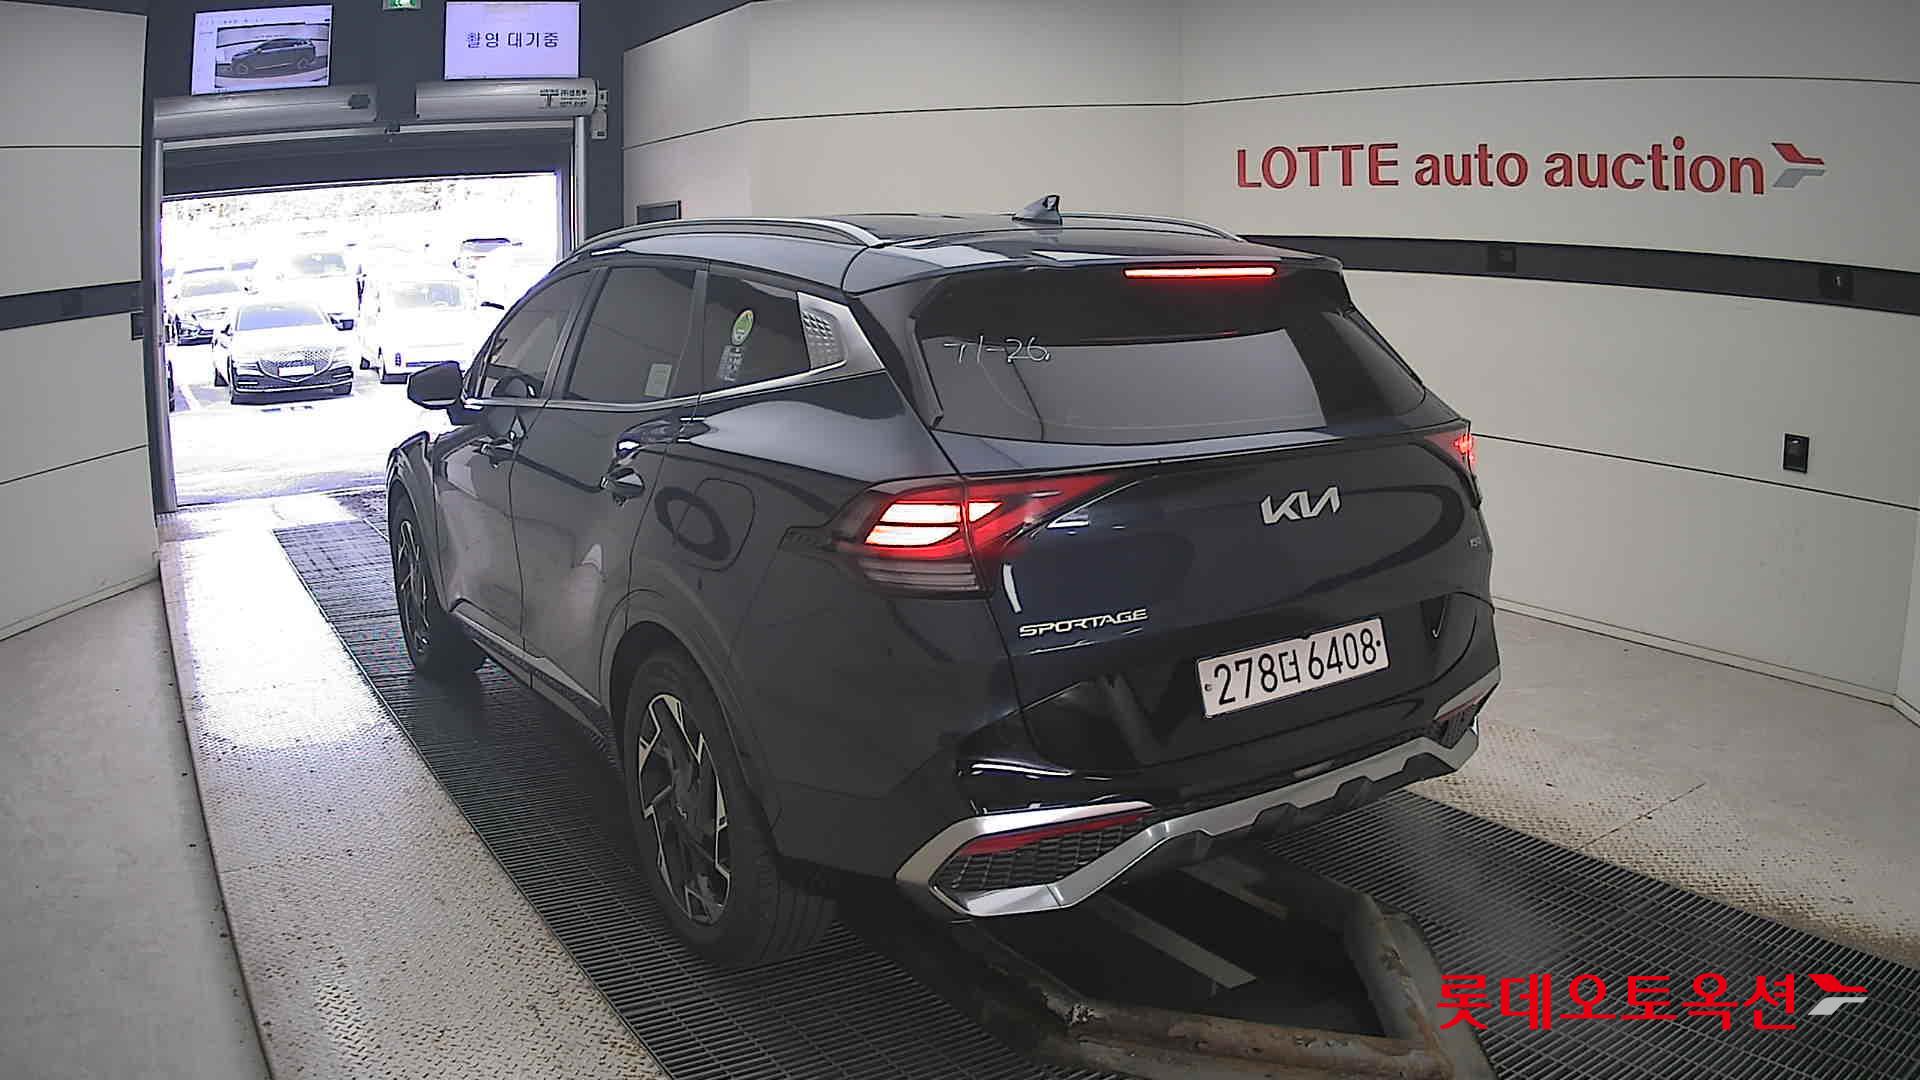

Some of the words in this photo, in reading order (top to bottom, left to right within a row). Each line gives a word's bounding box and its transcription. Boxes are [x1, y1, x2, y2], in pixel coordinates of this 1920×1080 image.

[507, 32, 559, 48] 대기중
[1237, 143, 1399, 189] LOTTE
[1414, 143, 1528, 187] auto
[1544, 136, 1764, 194] auction
[1261, 486, 1341, 525] KIA
[1019, 608, 1148, 637] SPORTAGE
